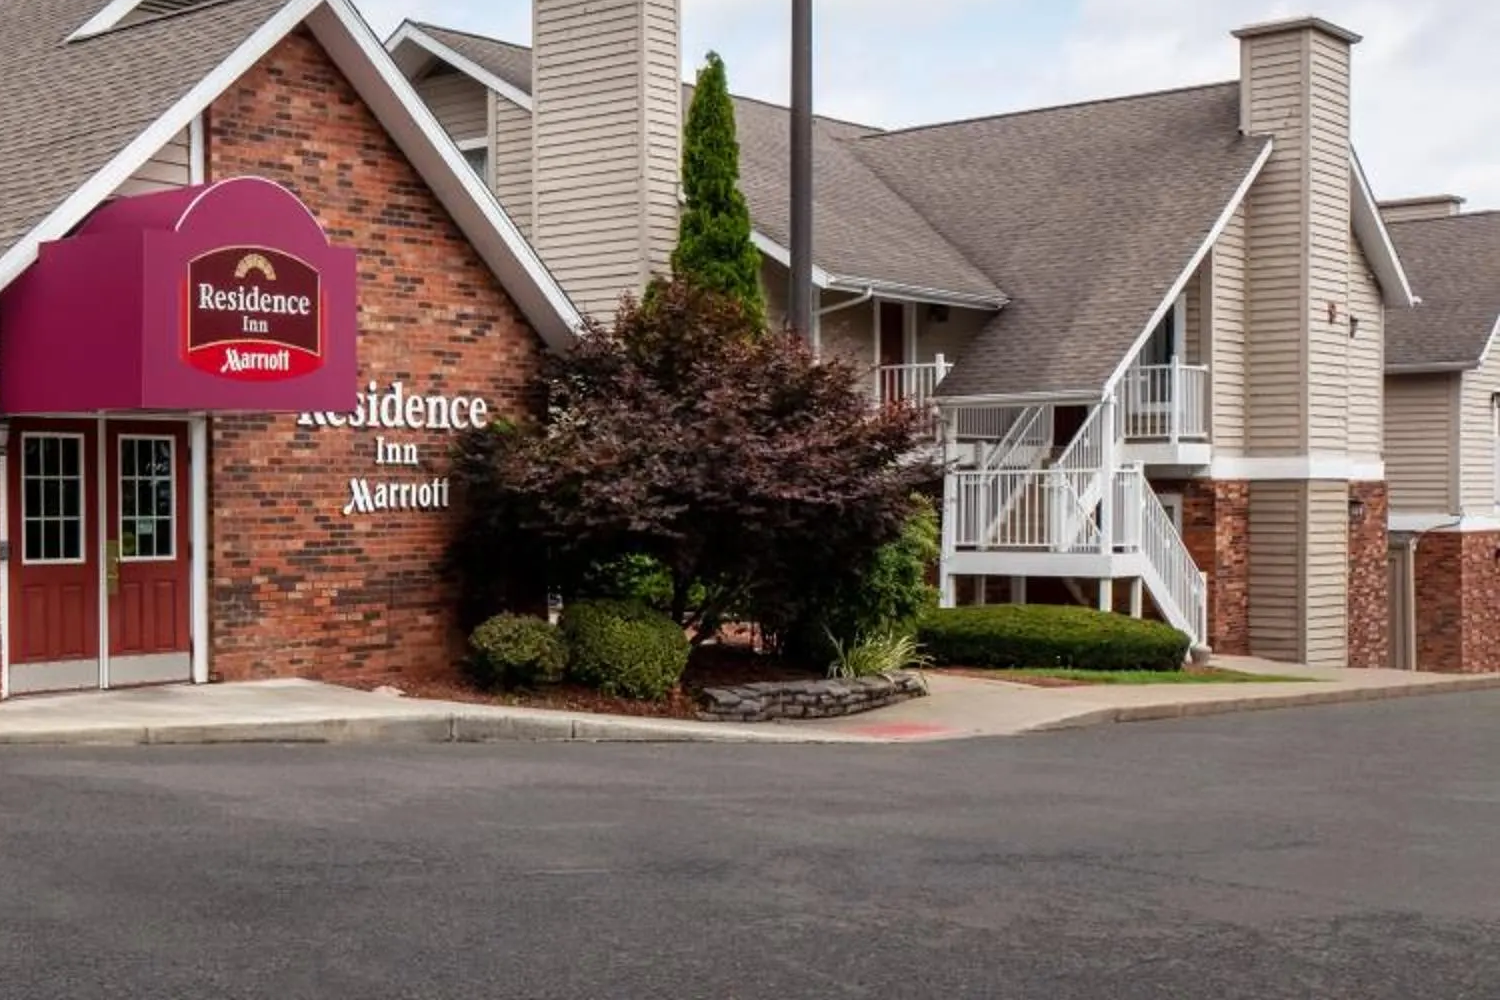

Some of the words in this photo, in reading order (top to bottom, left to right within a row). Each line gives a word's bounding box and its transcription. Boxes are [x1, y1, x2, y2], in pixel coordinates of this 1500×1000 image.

[198, 283, 311, 315] Residence
[243, 315, 269, 333] Inn
[220, 348, 290, 373] Marriott
[297, 380, 487, 429] sidence
[375, 436, 419, 465] Inn
[343, 477, 450, 515] Marriott
